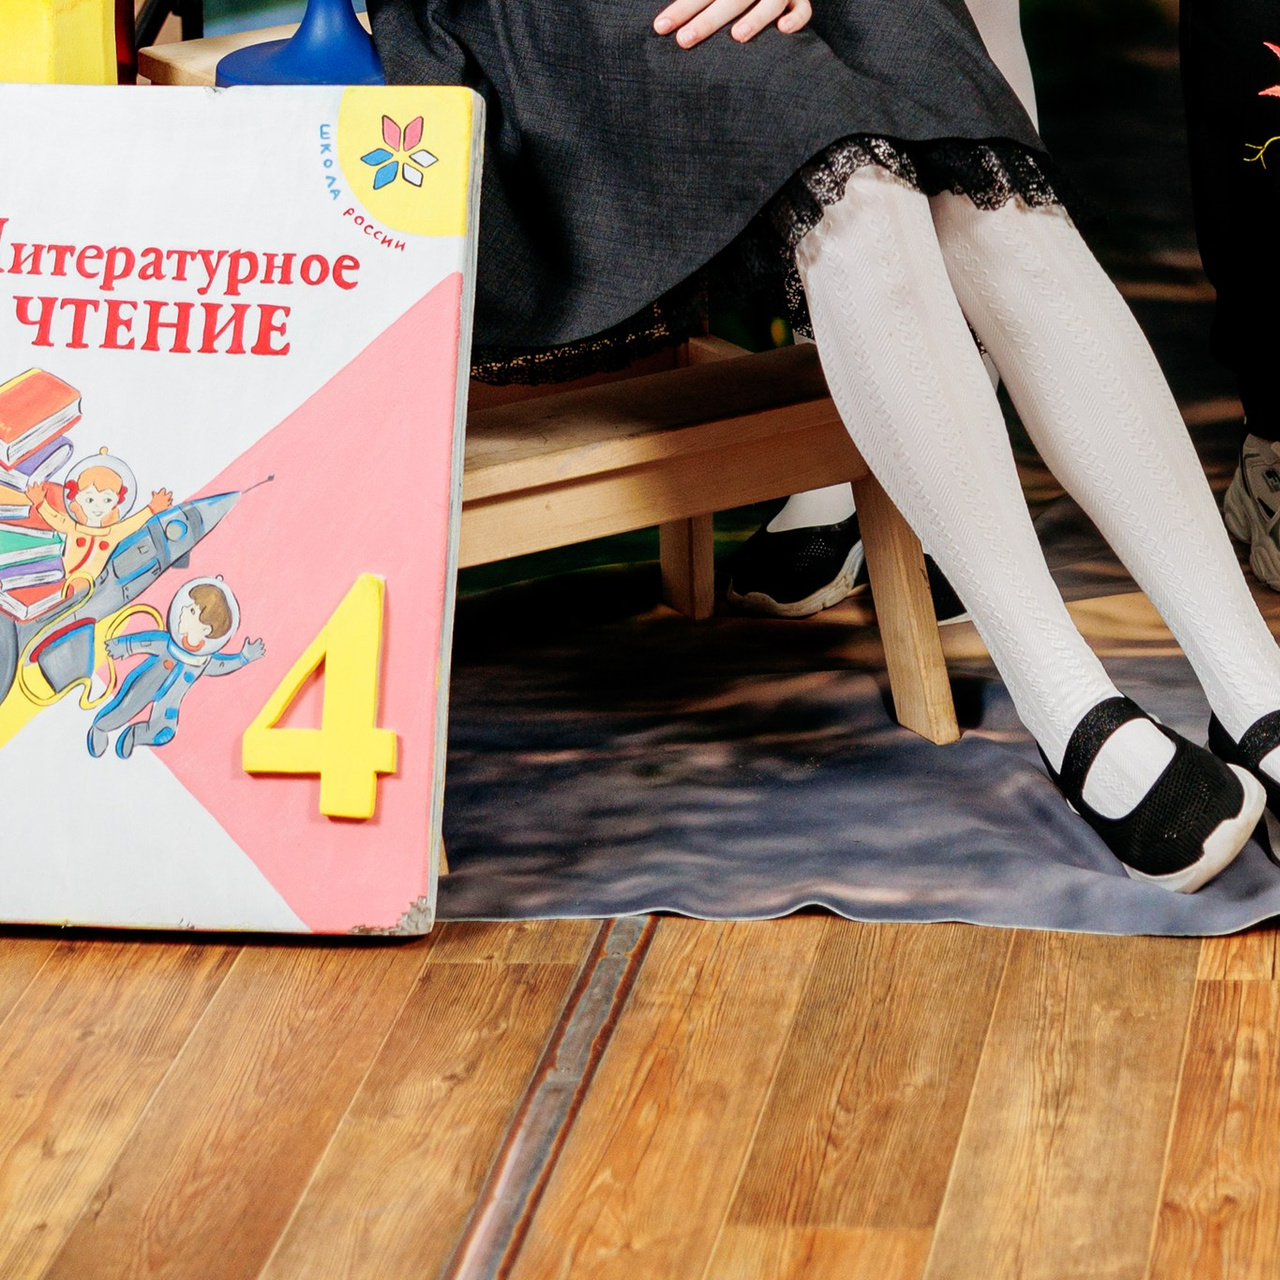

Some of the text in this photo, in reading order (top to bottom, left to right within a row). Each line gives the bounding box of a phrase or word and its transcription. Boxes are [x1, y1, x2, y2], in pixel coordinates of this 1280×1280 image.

[319, 123, 406, 251] ШКОЛА РОССИИ
[13, 295, 291, 356] ЧТЕНИЕ
[242, 572, 398, 819] 4
